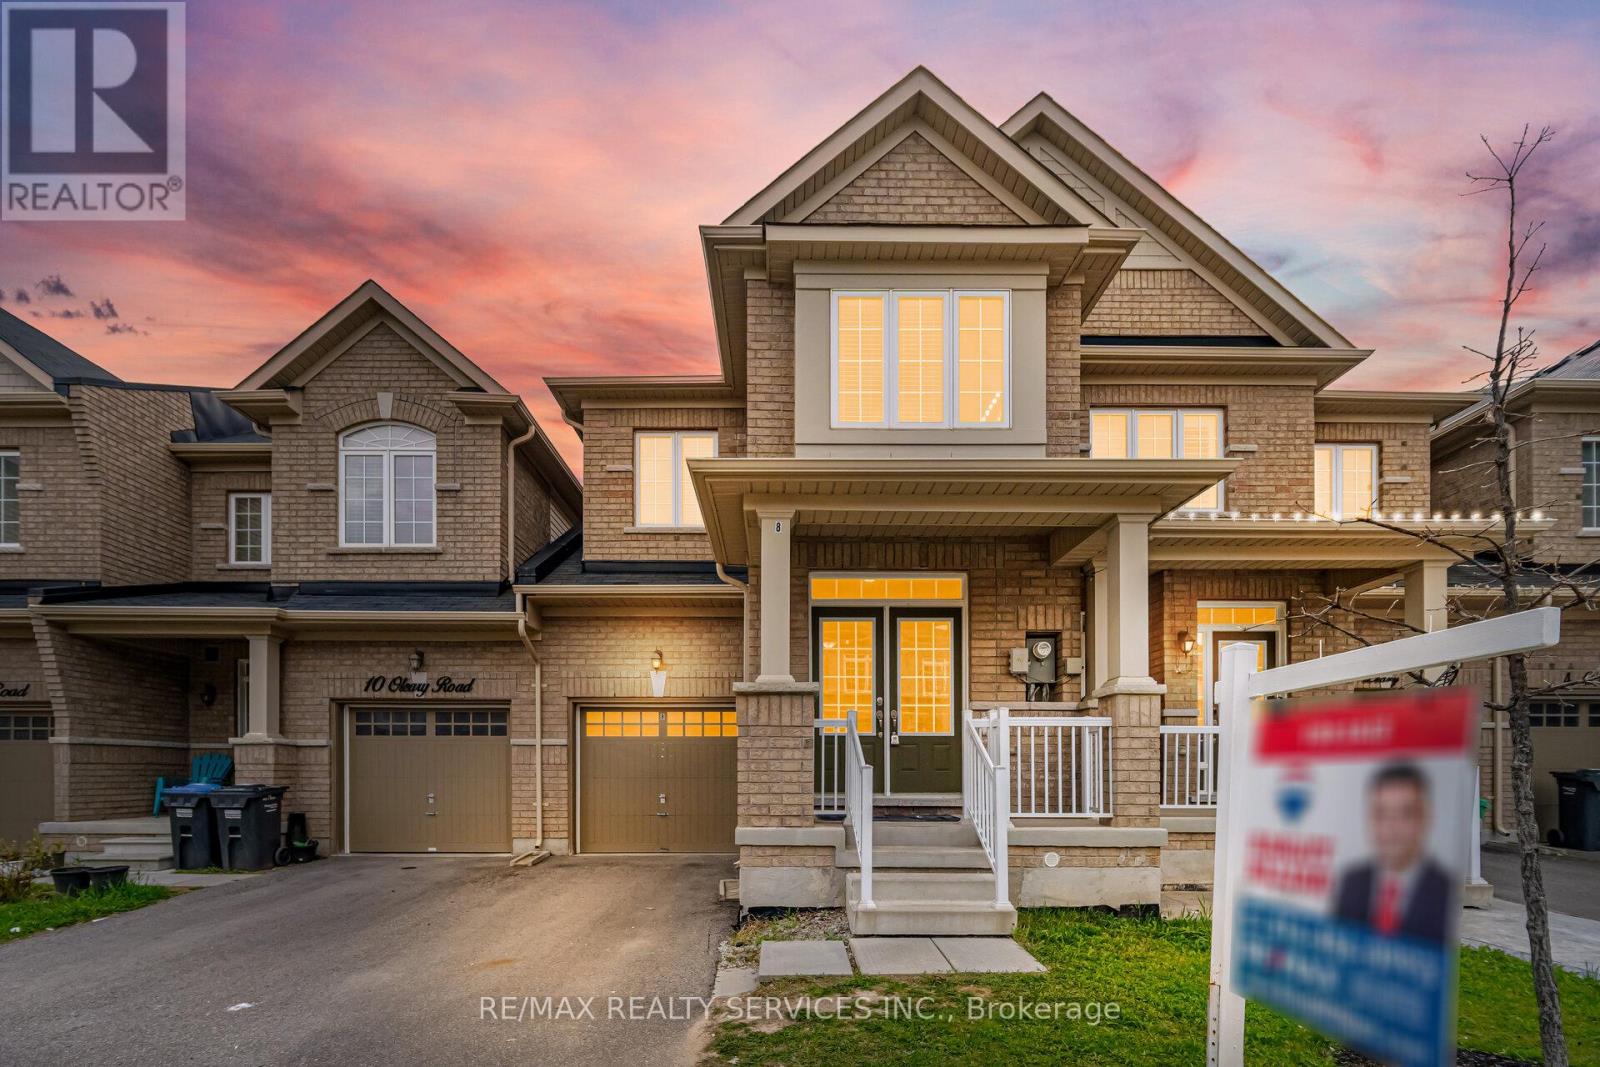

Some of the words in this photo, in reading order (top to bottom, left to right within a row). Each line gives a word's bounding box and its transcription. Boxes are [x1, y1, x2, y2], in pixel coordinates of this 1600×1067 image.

[775, 522, 782, 533] 8
[363, 675, 387, 693] 10
[431, 675, 476, 693] Road
